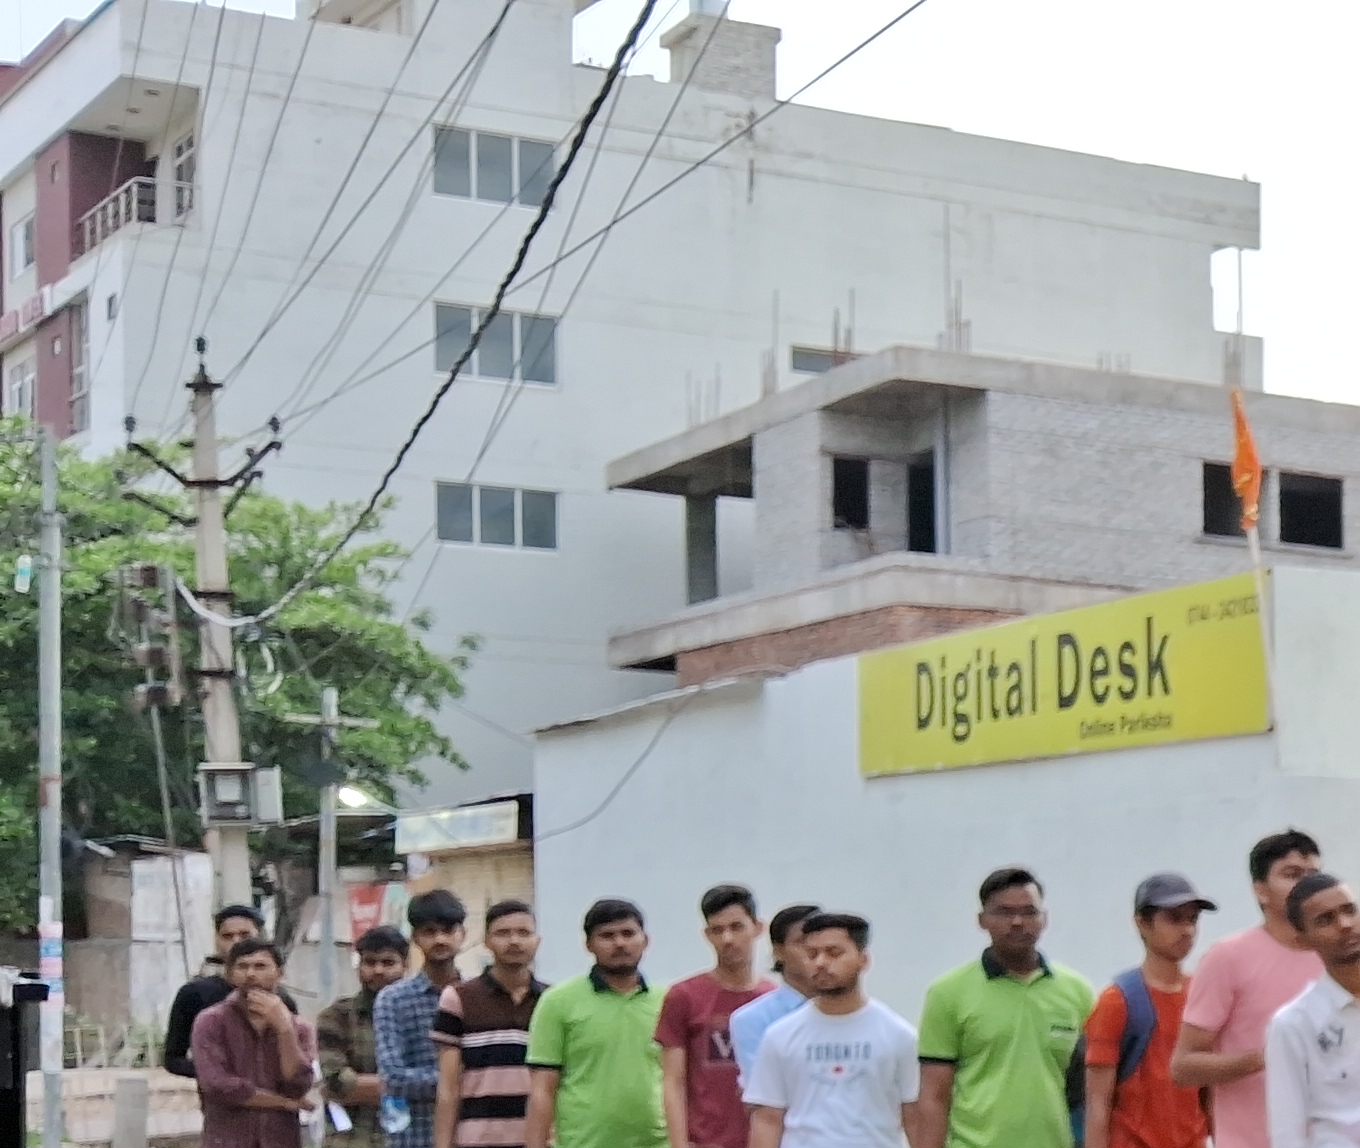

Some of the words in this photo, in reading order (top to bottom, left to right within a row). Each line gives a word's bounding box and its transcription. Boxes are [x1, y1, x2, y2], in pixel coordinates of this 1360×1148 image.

[915, 635, 1038, 744] Digital
[1056, 616, 1171, 710] Desk
[806, 1041, 872, 1062] TORONTO
